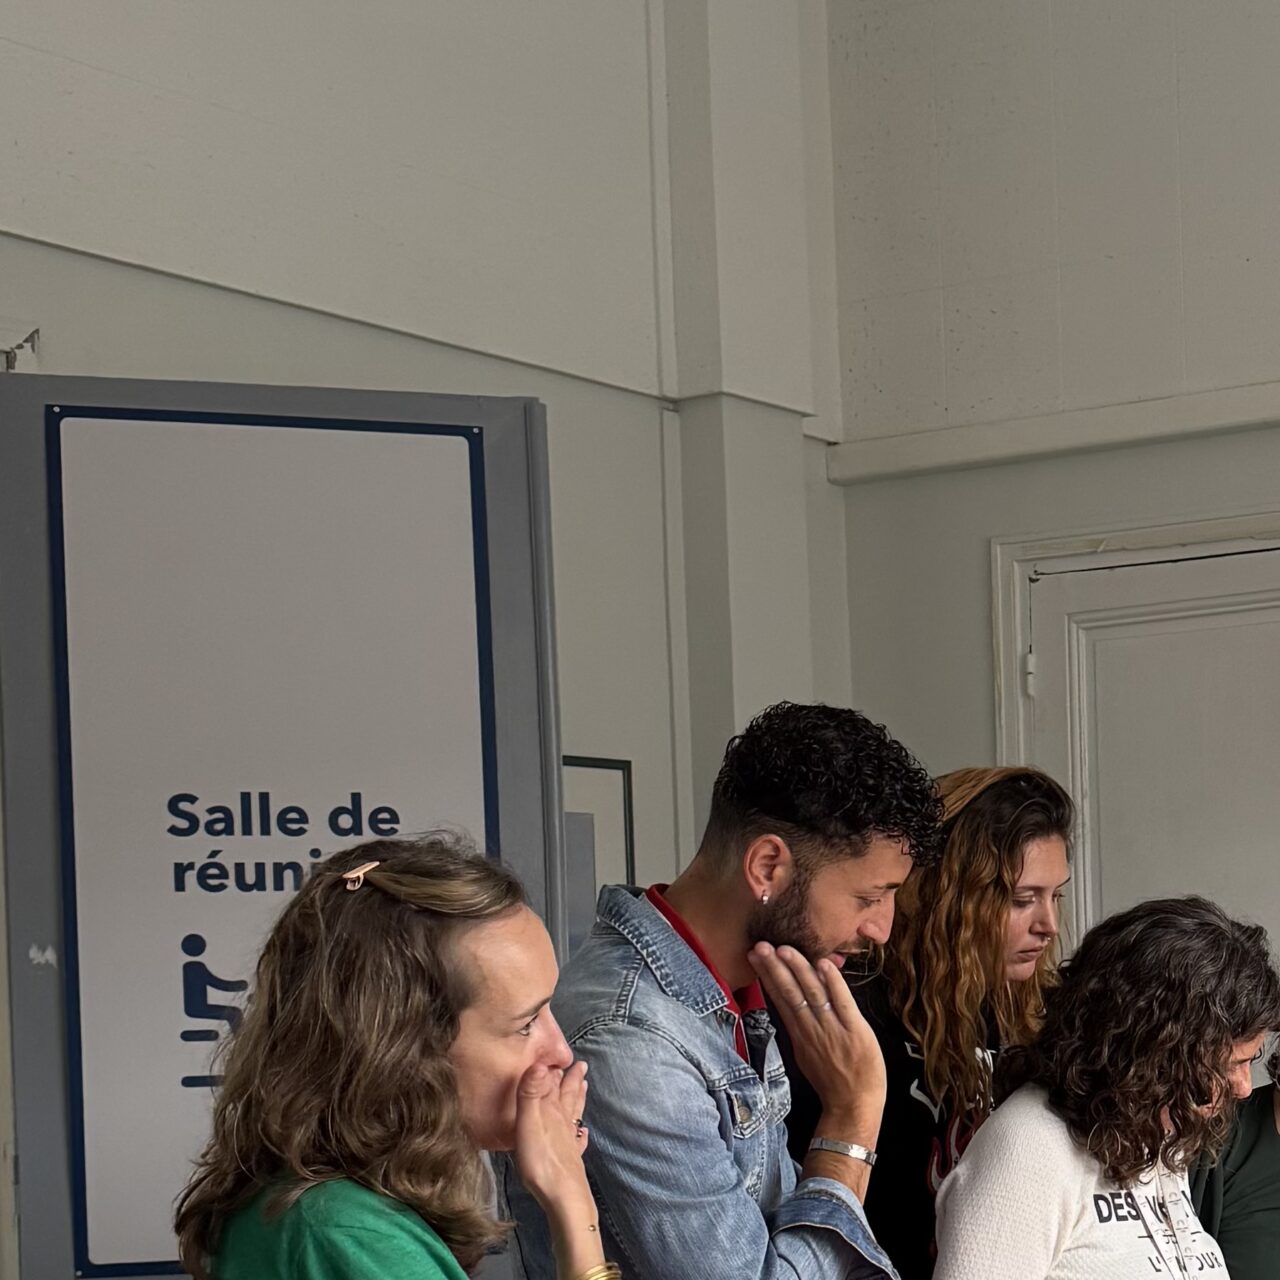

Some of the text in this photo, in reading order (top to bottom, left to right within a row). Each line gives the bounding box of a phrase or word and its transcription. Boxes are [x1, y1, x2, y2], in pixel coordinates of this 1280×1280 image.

[166, 791, 400, 837] Salle de
[173, 848, 322, 893] réun
